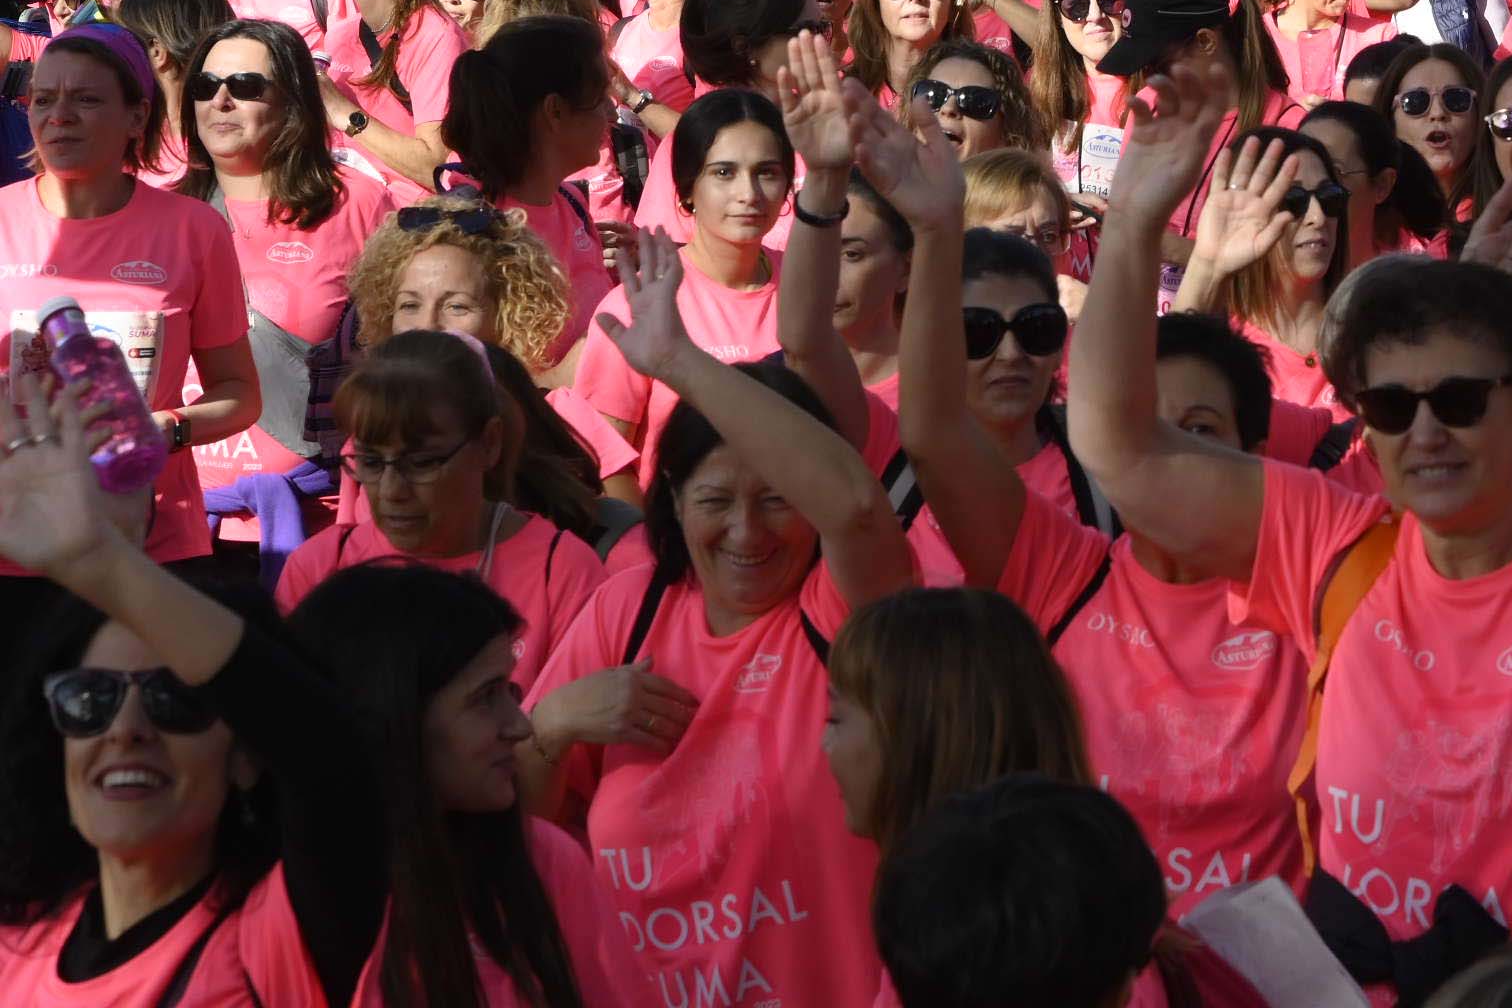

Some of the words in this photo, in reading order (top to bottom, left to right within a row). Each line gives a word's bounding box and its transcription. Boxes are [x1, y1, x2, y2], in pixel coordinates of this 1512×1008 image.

[1328, 786, 1385, 844] TU
[601, 846, 654, 891] TU
[657, 959, 773, 1008] UMA
